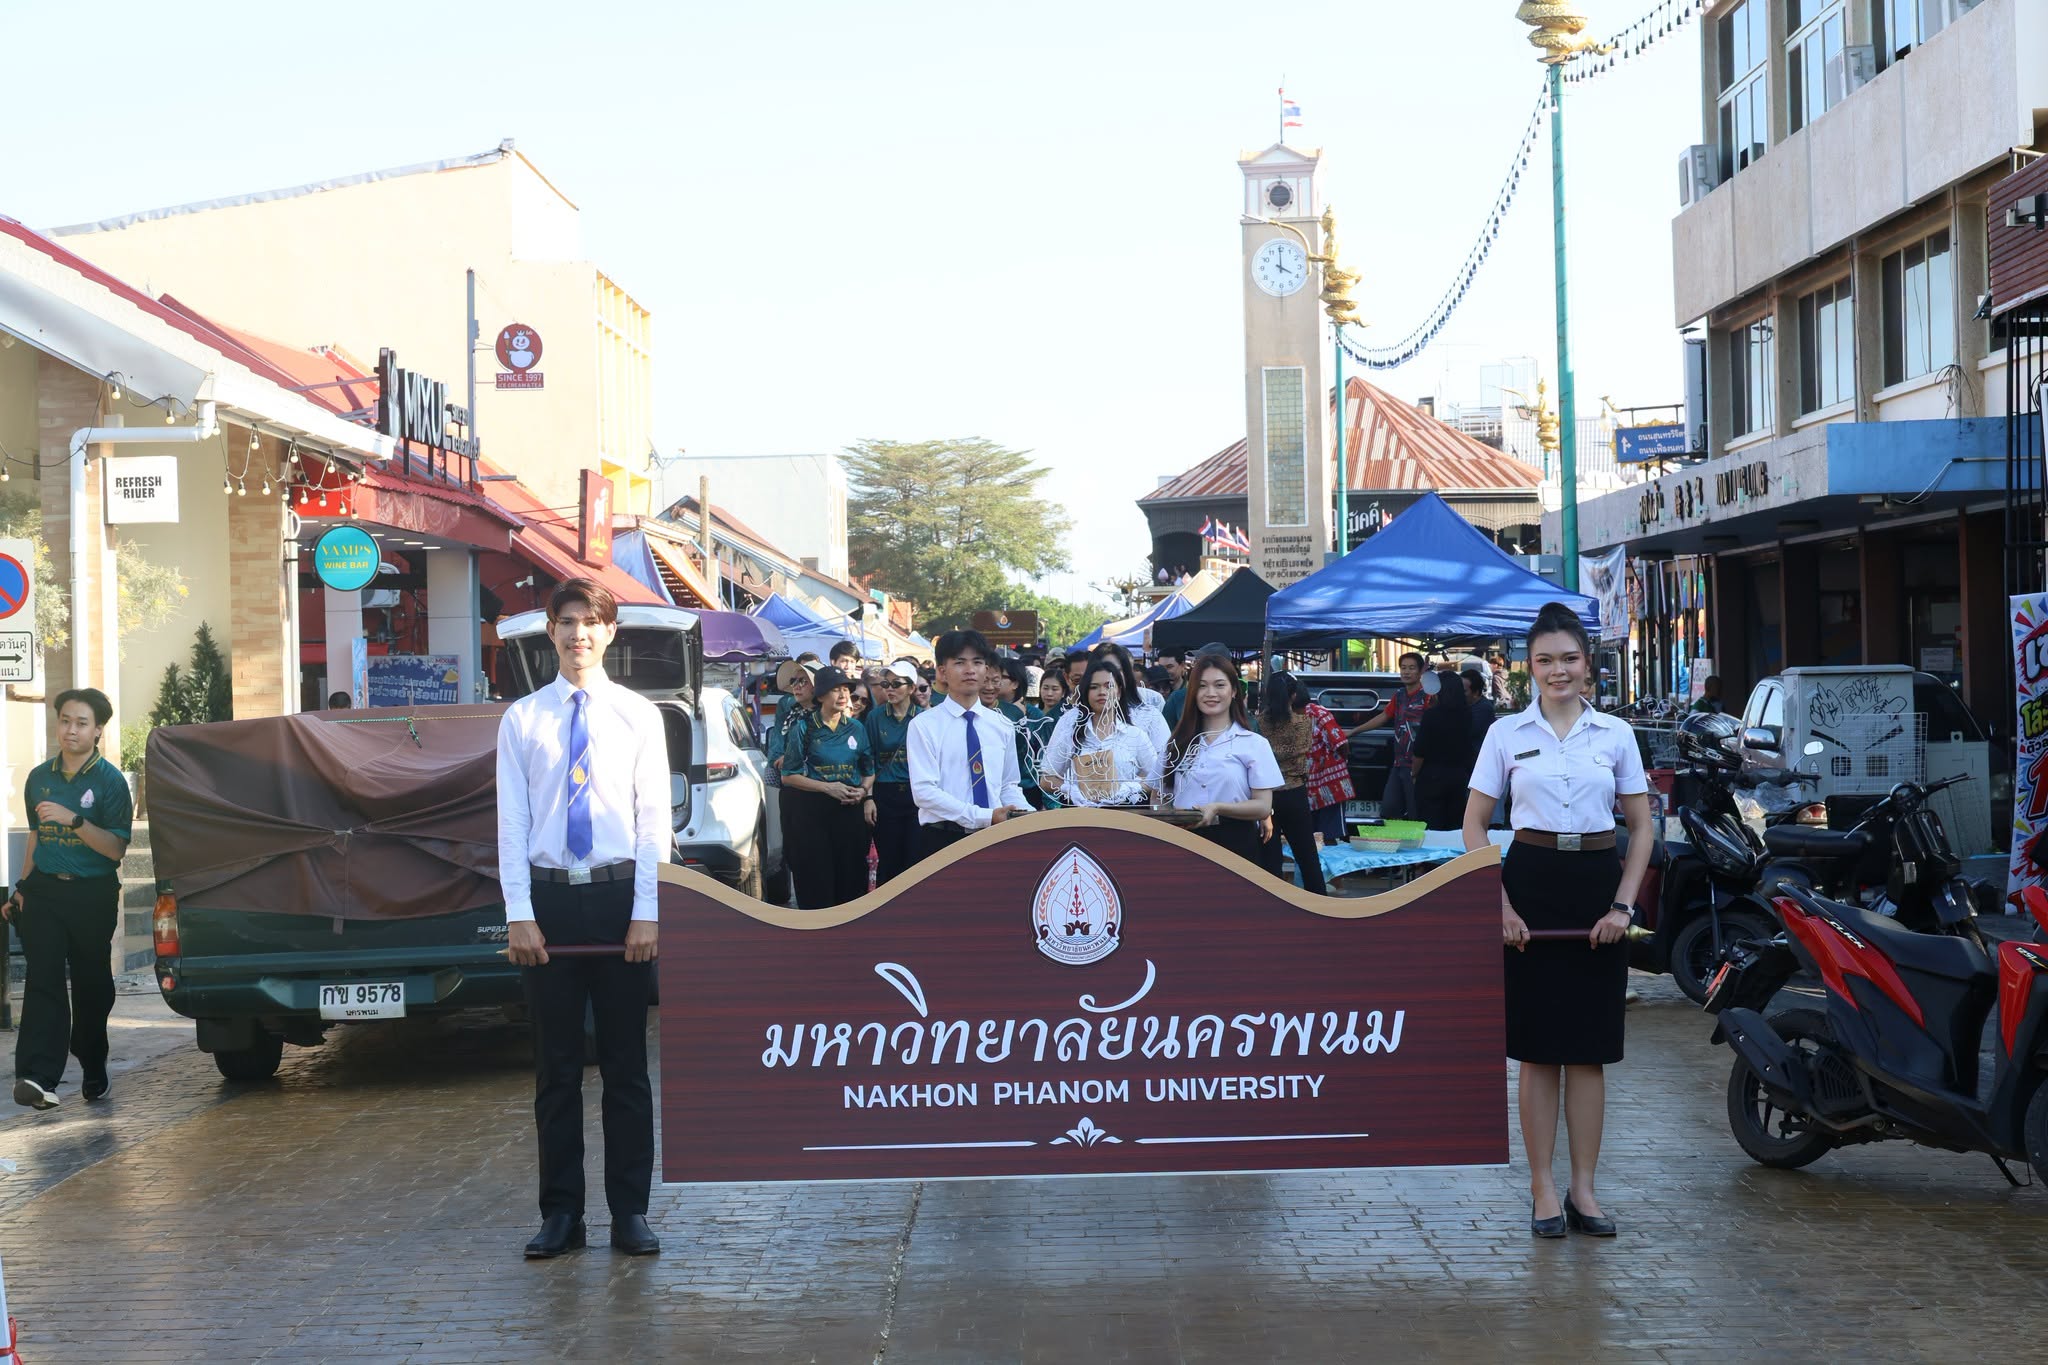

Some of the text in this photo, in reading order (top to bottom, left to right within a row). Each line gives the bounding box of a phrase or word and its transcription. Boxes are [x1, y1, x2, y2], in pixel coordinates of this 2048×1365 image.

[497, 373, 542, 382] SINCE 1997
[115, 475, 162, 488] REFRESH
[123, 487, 155, 499] RIVER
[322, 544, 372, 556] VAMPS
[324, 561, 369, 569] WINE BAR
[1829, 920, 1866, 949] CLICK
[323, 984, 401, 1005] กข 9578
[762, 959, 1405, 1068] มหาวิทยาลัยนครพนม
[844, 1074, 1325, 1109] NAKHON PHANOM UNIVERSITY
